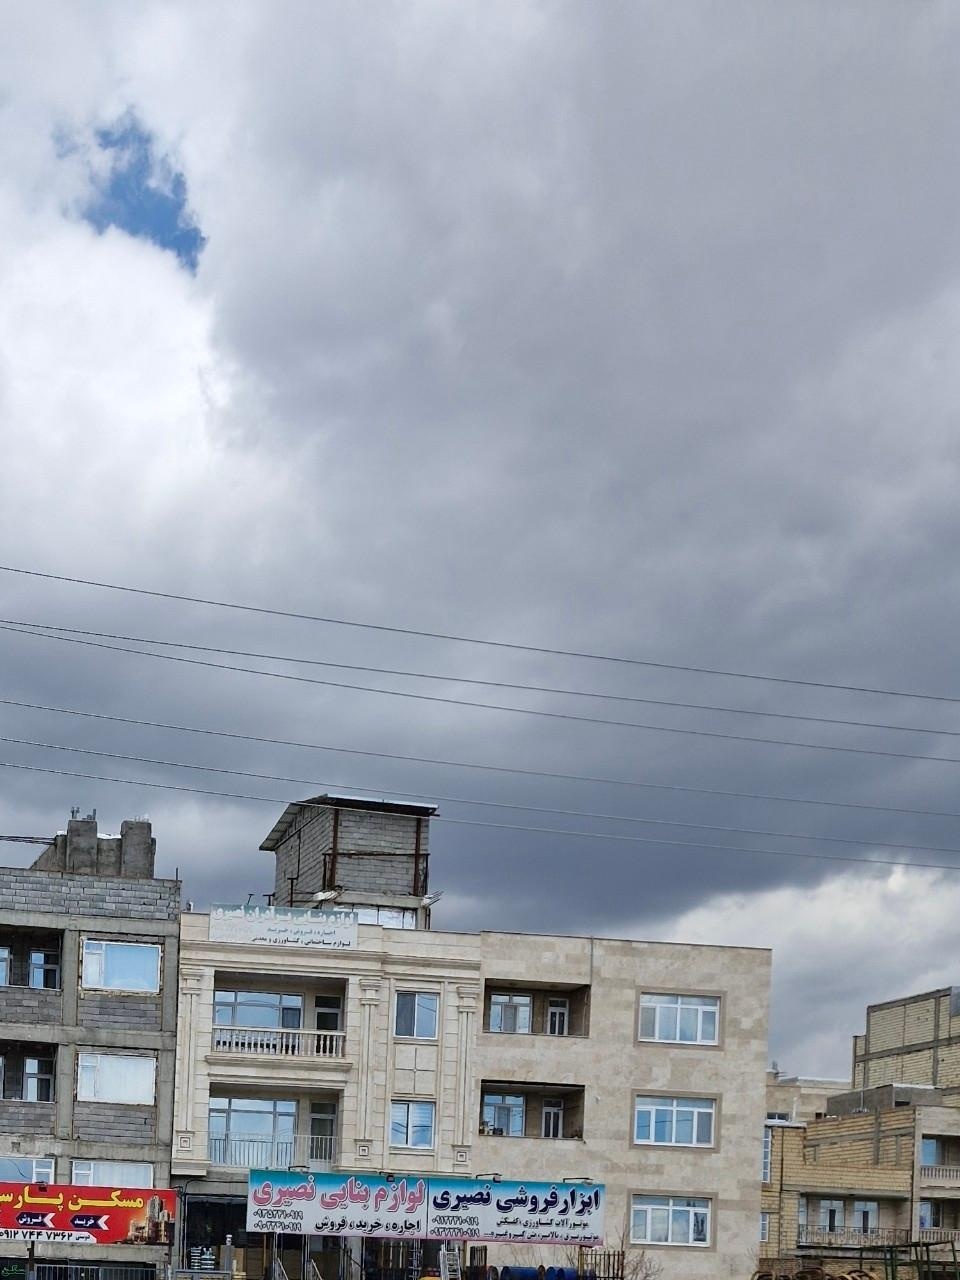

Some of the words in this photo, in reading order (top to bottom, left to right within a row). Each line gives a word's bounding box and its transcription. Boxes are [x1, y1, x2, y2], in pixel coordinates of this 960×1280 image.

[68, 1190, 144, 1211] مسکن
[252, 1176, 317, 1208] نصیری
[320, 1177, 371, 1210] بنایی
[373, 1178, 425, 1212] لوازم
[432, 1183, 492, 1211] نصیری
[17, 1212, 43, 1226] فروش
[74, 1215, 96, 1229] خرید
[315, 1215, 347, 1232] فروش
[522, 1217, 554, 1229] کشاورزی
[0, 1229, 19, 1239] ۰۹۱۲
